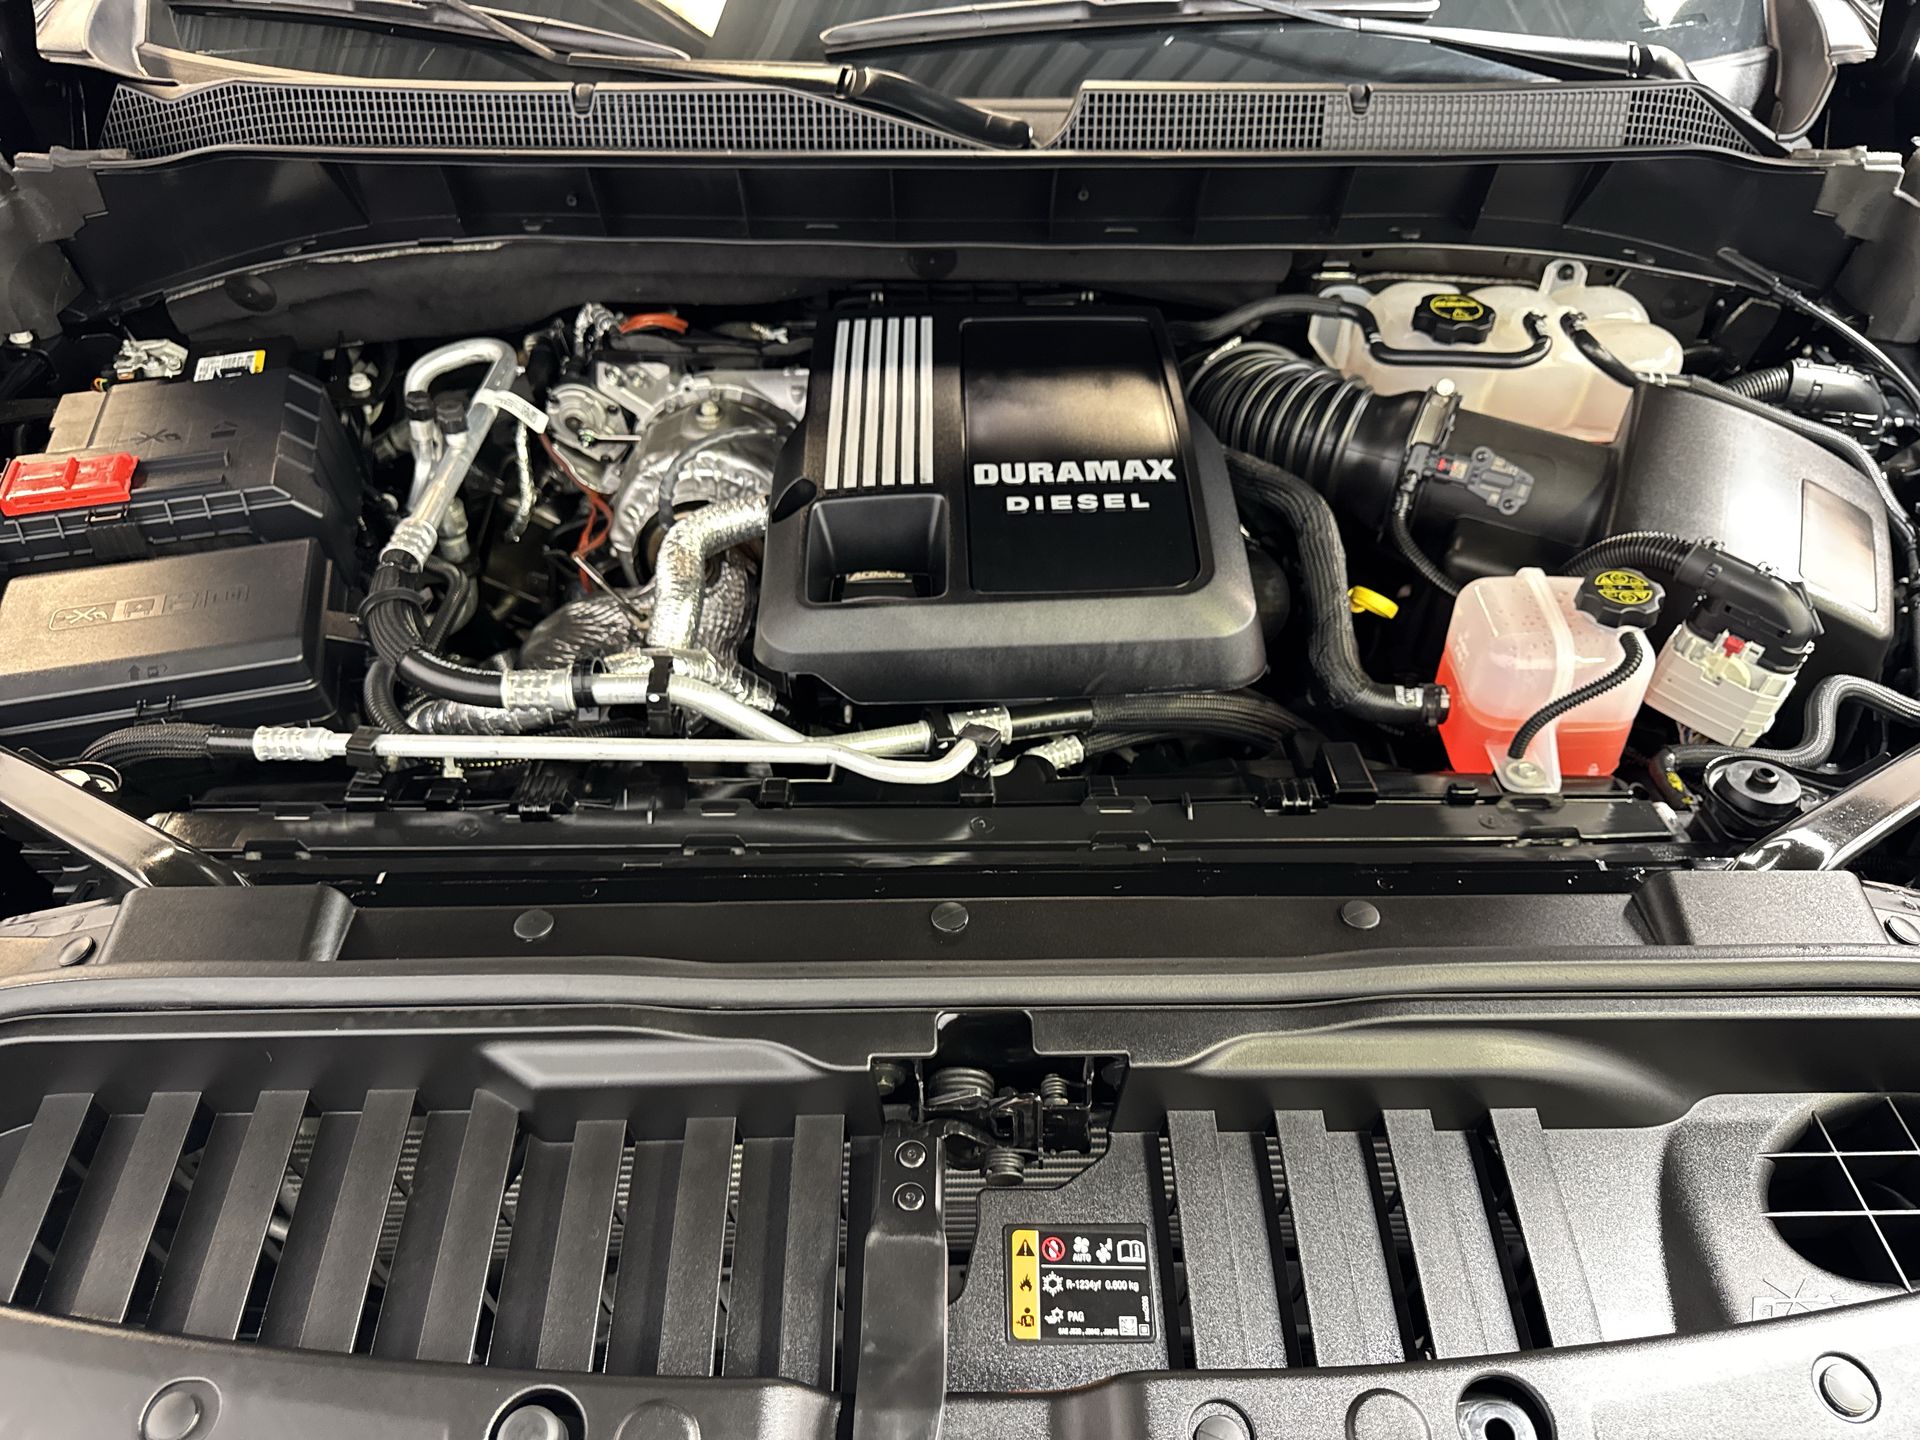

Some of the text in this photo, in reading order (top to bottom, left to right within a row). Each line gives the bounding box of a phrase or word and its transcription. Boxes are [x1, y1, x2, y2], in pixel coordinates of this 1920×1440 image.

[973, 458, 1176, 485] DURAMAX
[1006, 493, 1150, 512] DIESEL
[1073, 1253, 1091, 1262] AUTO
[1066, 1279, 1101, 1291] R-1234yf
[1128, 1280, 1138, 1292] kg
[1067, 1310, 1085, 1322] PAG
